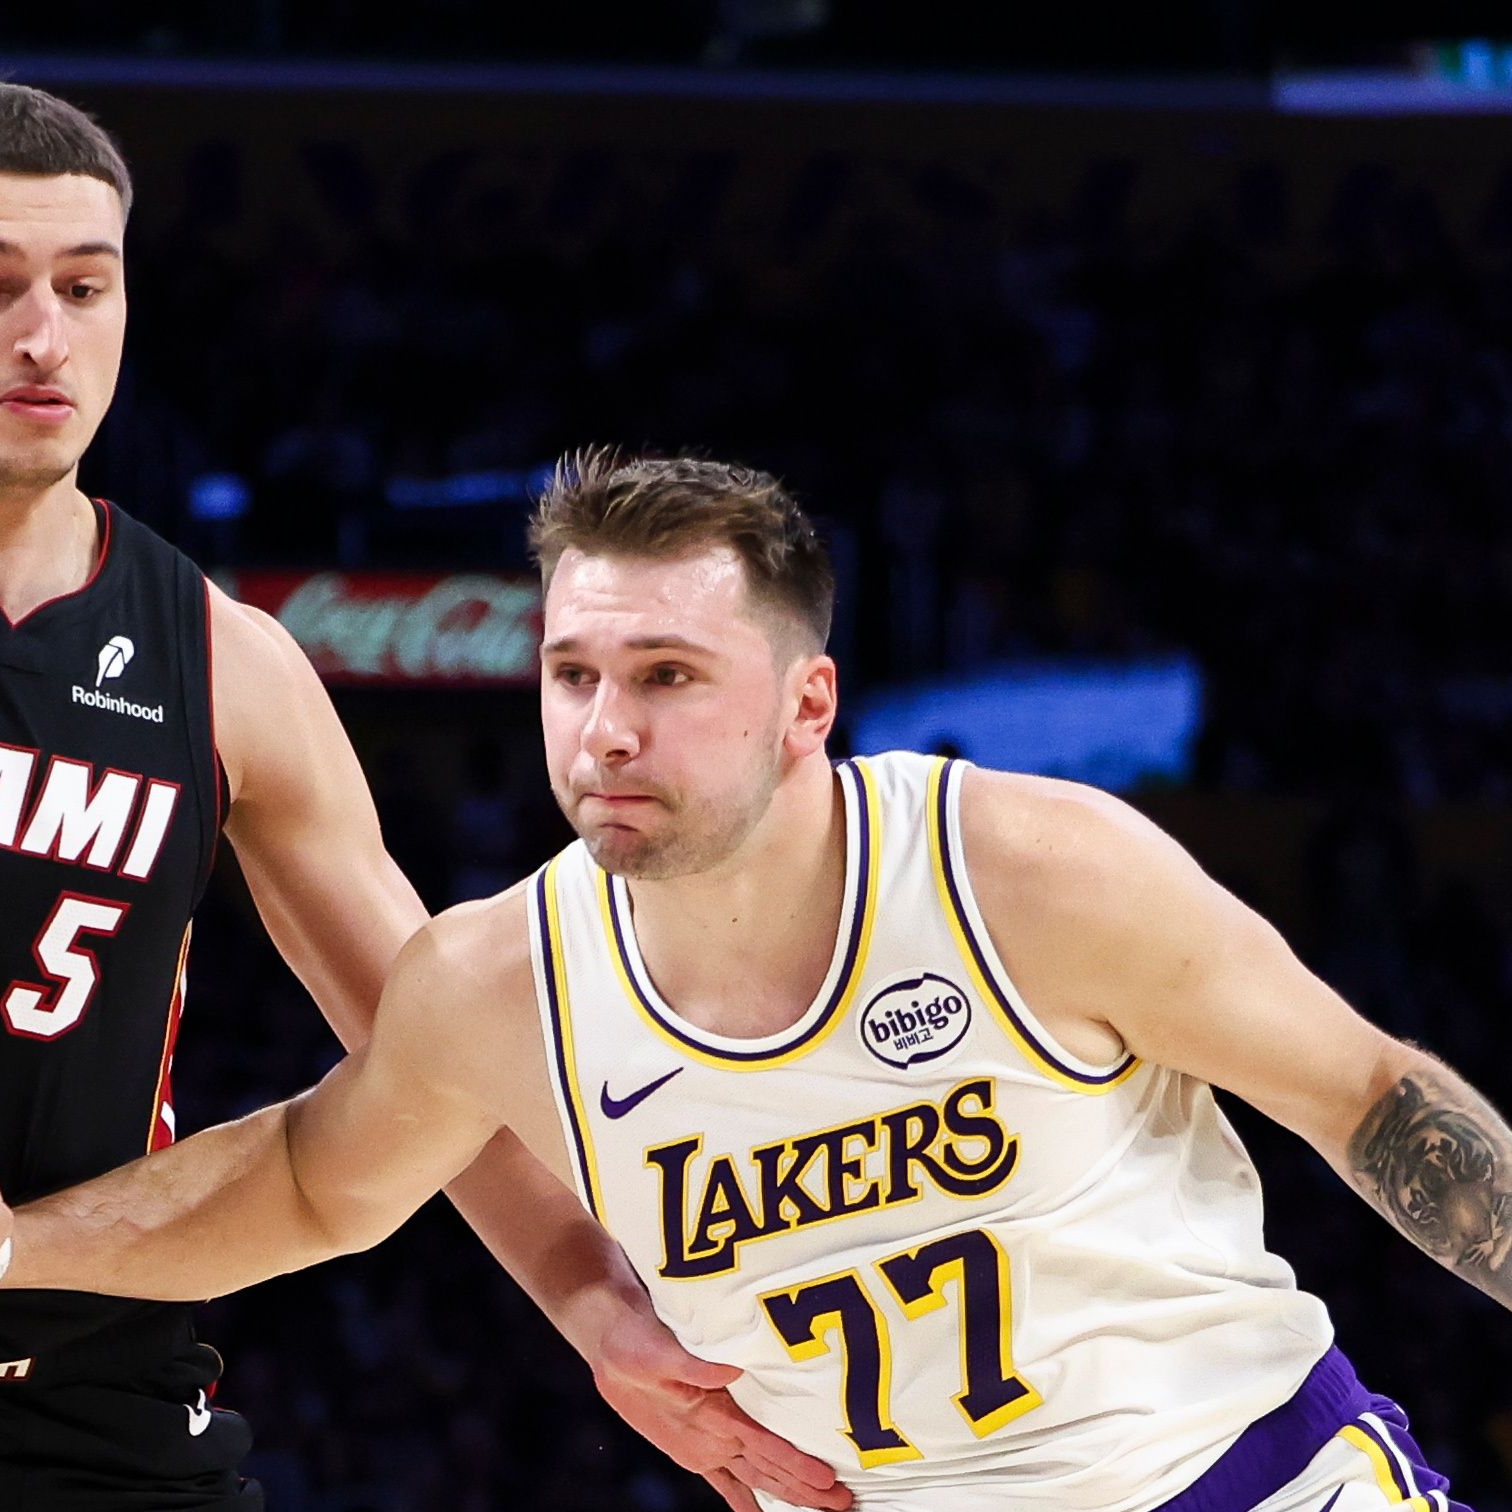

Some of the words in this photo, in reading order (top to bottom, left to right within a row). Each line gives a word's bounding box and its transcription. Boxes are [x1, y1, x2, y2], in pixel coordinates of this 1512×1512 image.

[71, 684, 164, 723] Robinhood
[0, 890, 131, 1041] 5
[868, 996, 962, 1043] bibigo
[893, 1028, 933, 1051] 비비고
[644, 1077, 1020, 1281] LAKERS
[757, 1228, 1043, 1470] 77
